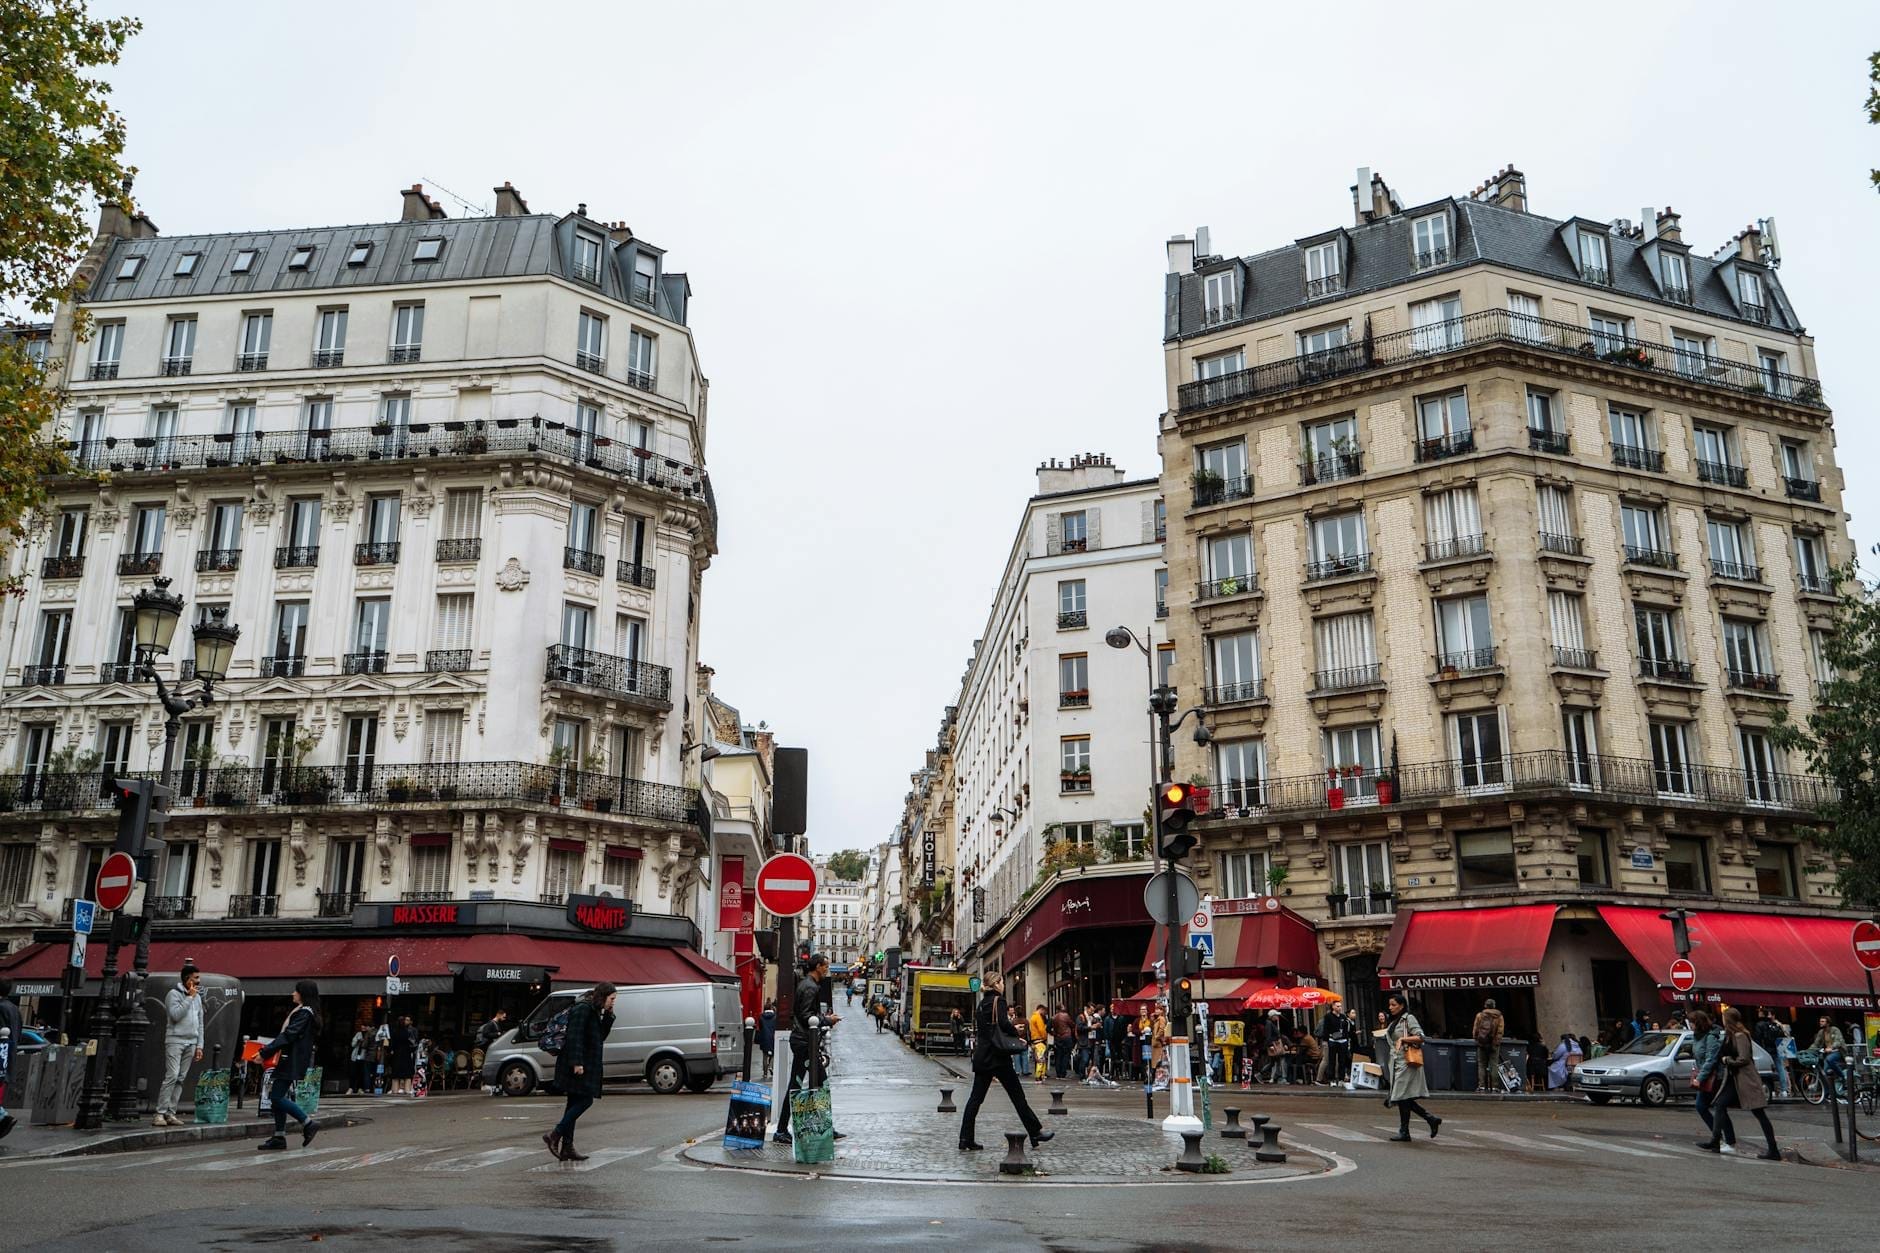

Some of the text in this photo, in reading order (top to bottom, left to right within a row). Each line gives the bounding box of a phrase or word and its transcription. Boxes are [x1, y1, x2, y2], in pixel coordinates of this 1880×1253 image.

[925, 832, 934, 881] HOTEL
[1236, 900, 1260, 911] Bar
[393, 904, 458, 923] BRASSERIE
[576, 903, 625, 929] MARMITE
[1196, 916, 1205, 924] 30
[486, 968, 521, 980] BRASSERIE
[1389, 974, 1539, 989] LA CANTINE DE LA CIGALE
[15, 984, 55, 994] RESTAURANT
[1707, 993, 1721, 1002] café
[1803, 995, 1816, 1006] LA
[1816, 996, 1853, 1007] CANTINE
[1853, 997, 1865, 1007] DE
